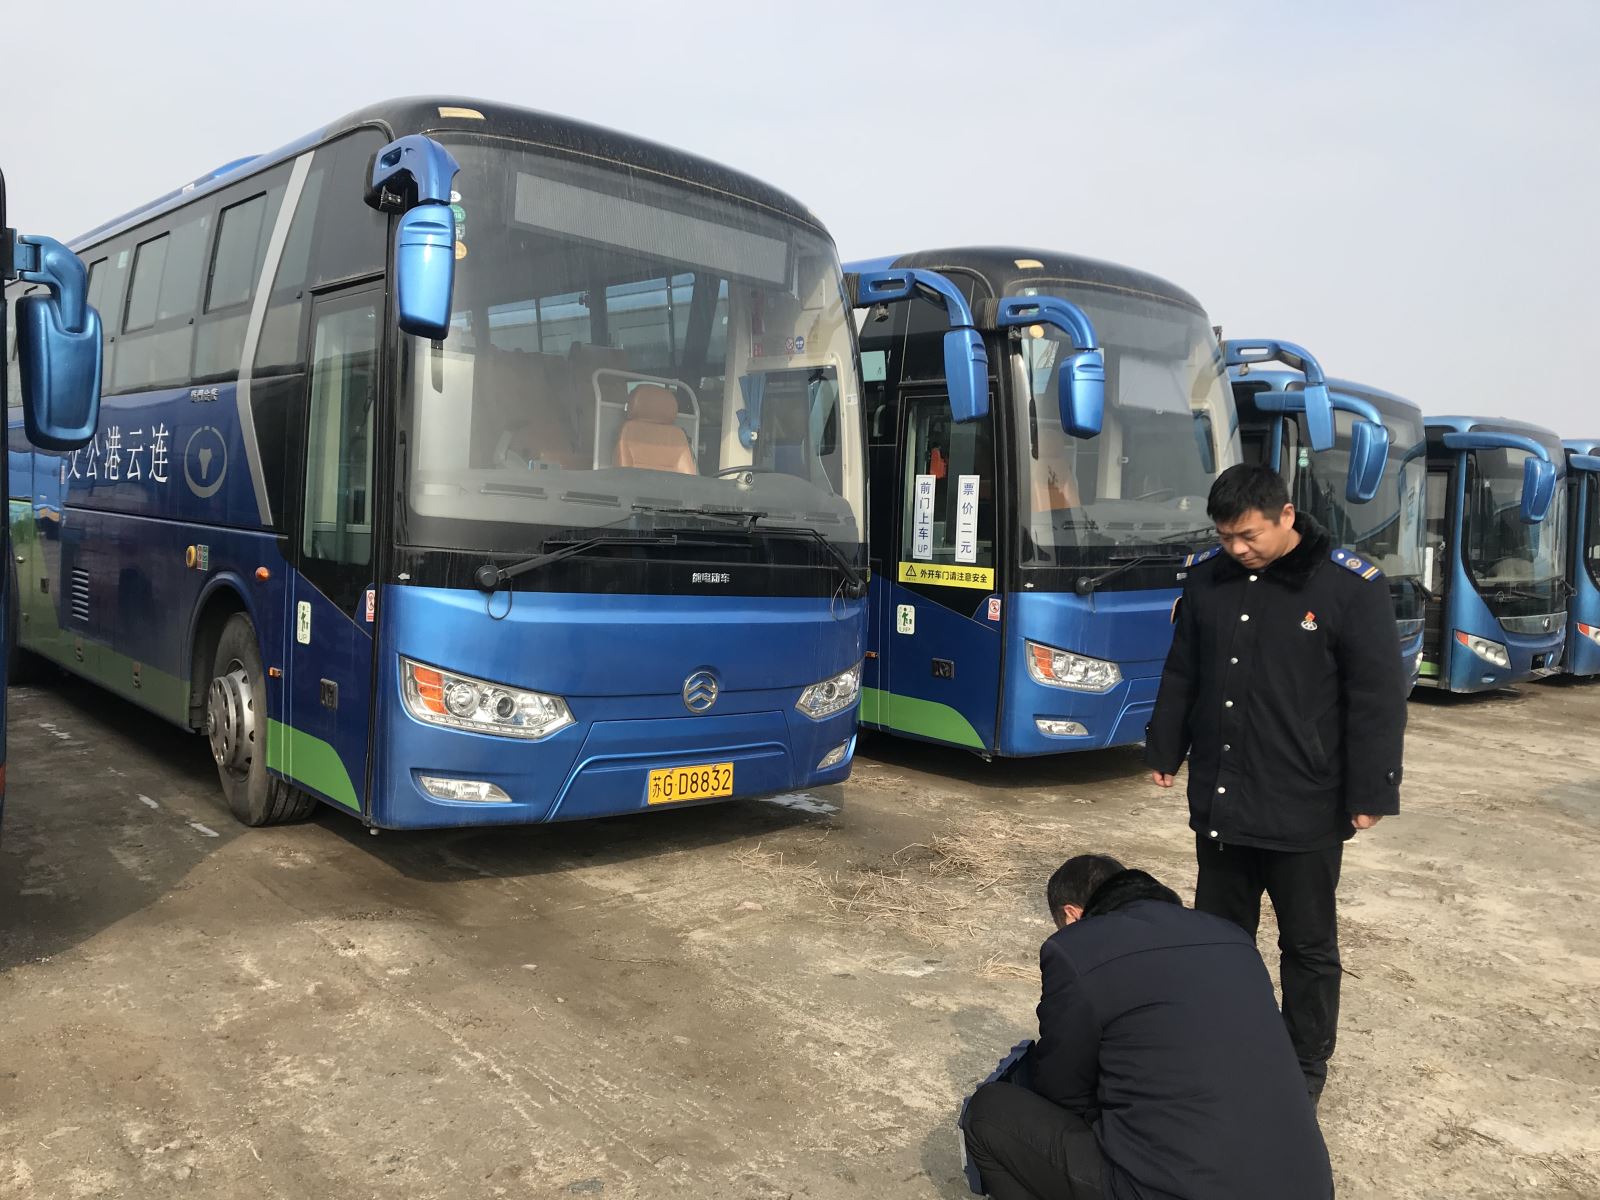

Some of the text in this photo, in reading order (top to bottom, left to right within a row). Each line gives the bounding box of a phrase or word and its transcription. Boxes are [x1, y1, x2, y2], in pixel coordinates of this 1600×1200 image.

[917, 482, 931, 553] 前门上车 UP
[961, 482, 975, 554] 票价二元
[920, 568, 988, 583] 外开车门请注意安全
